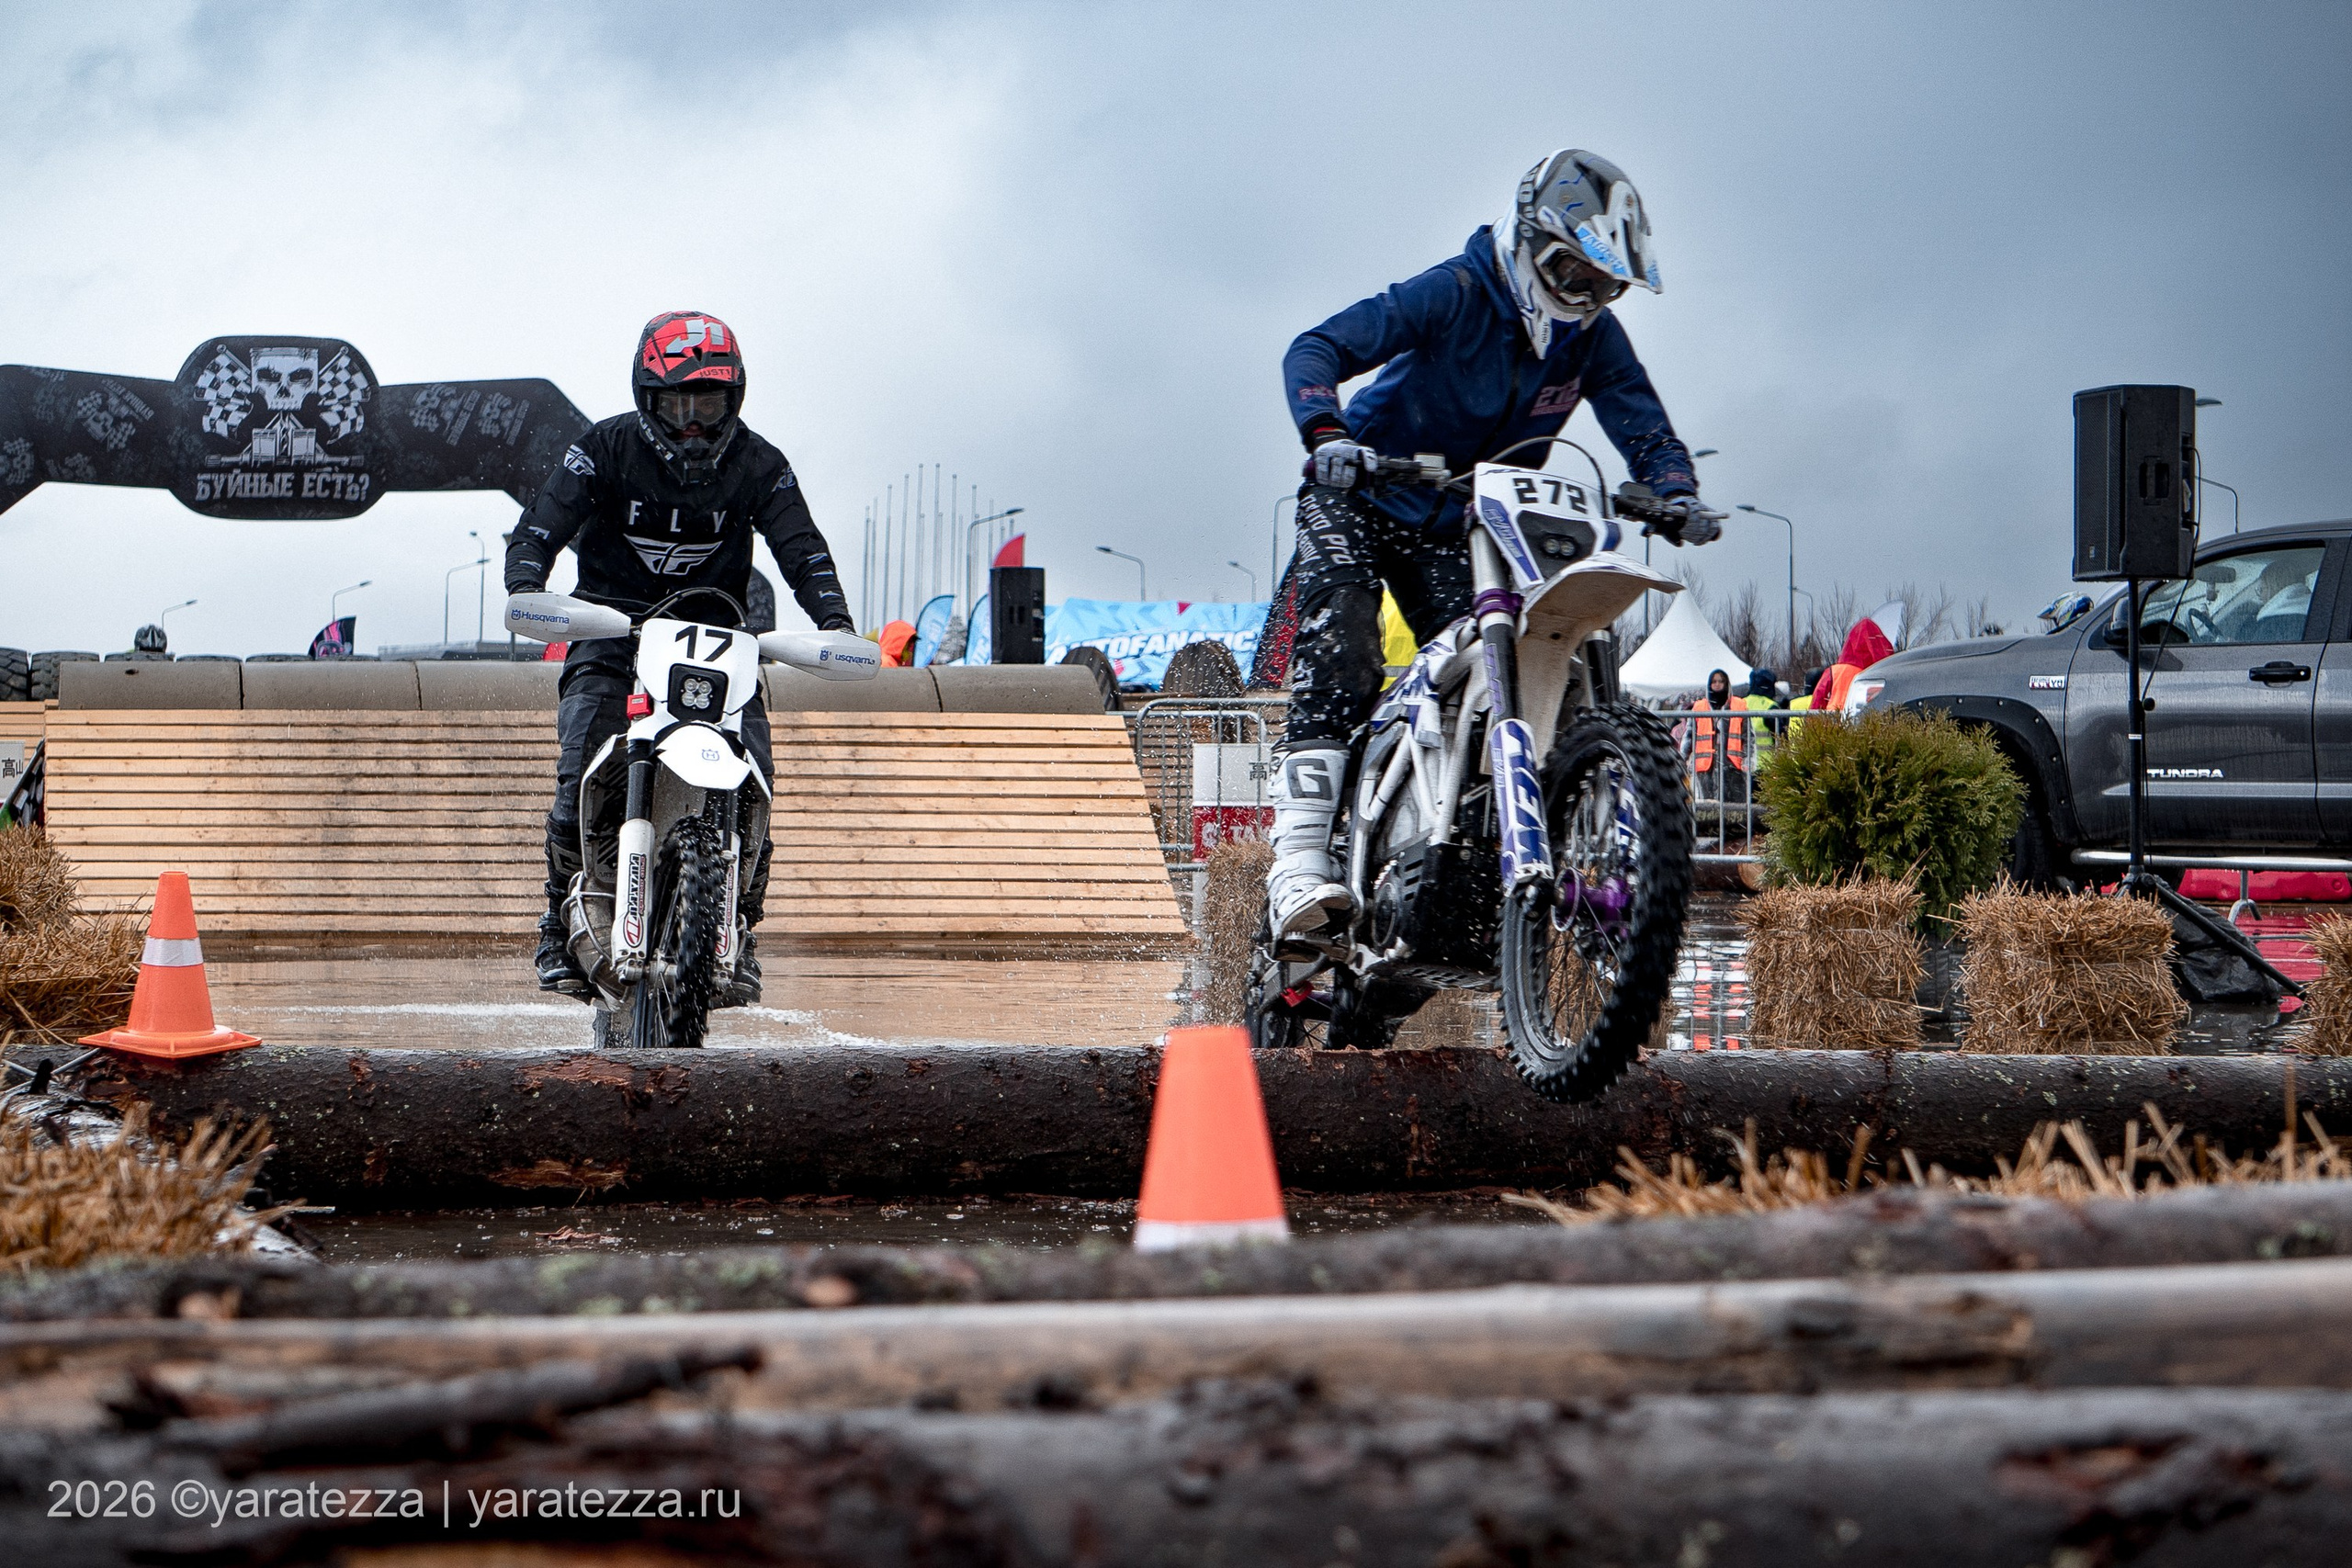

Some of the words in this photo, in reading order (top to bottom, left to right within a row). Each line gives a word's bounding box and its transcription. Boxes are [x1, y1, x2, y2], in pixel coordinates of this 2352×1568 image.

[196, 469, 295, 502] БУЙНЫЕ
[301, 470, 370, 502] ЕСТЬ?
[1512, 478, 1589, 514] 272
[628, 500, 727, 533] FLY
[521, 611, 570, 624] Husqvarna
[674, 626, 733, 661] 17
[829, 651, 876, 665] usqvarna
[2146, 768, 2224, 778] TUNDRA
